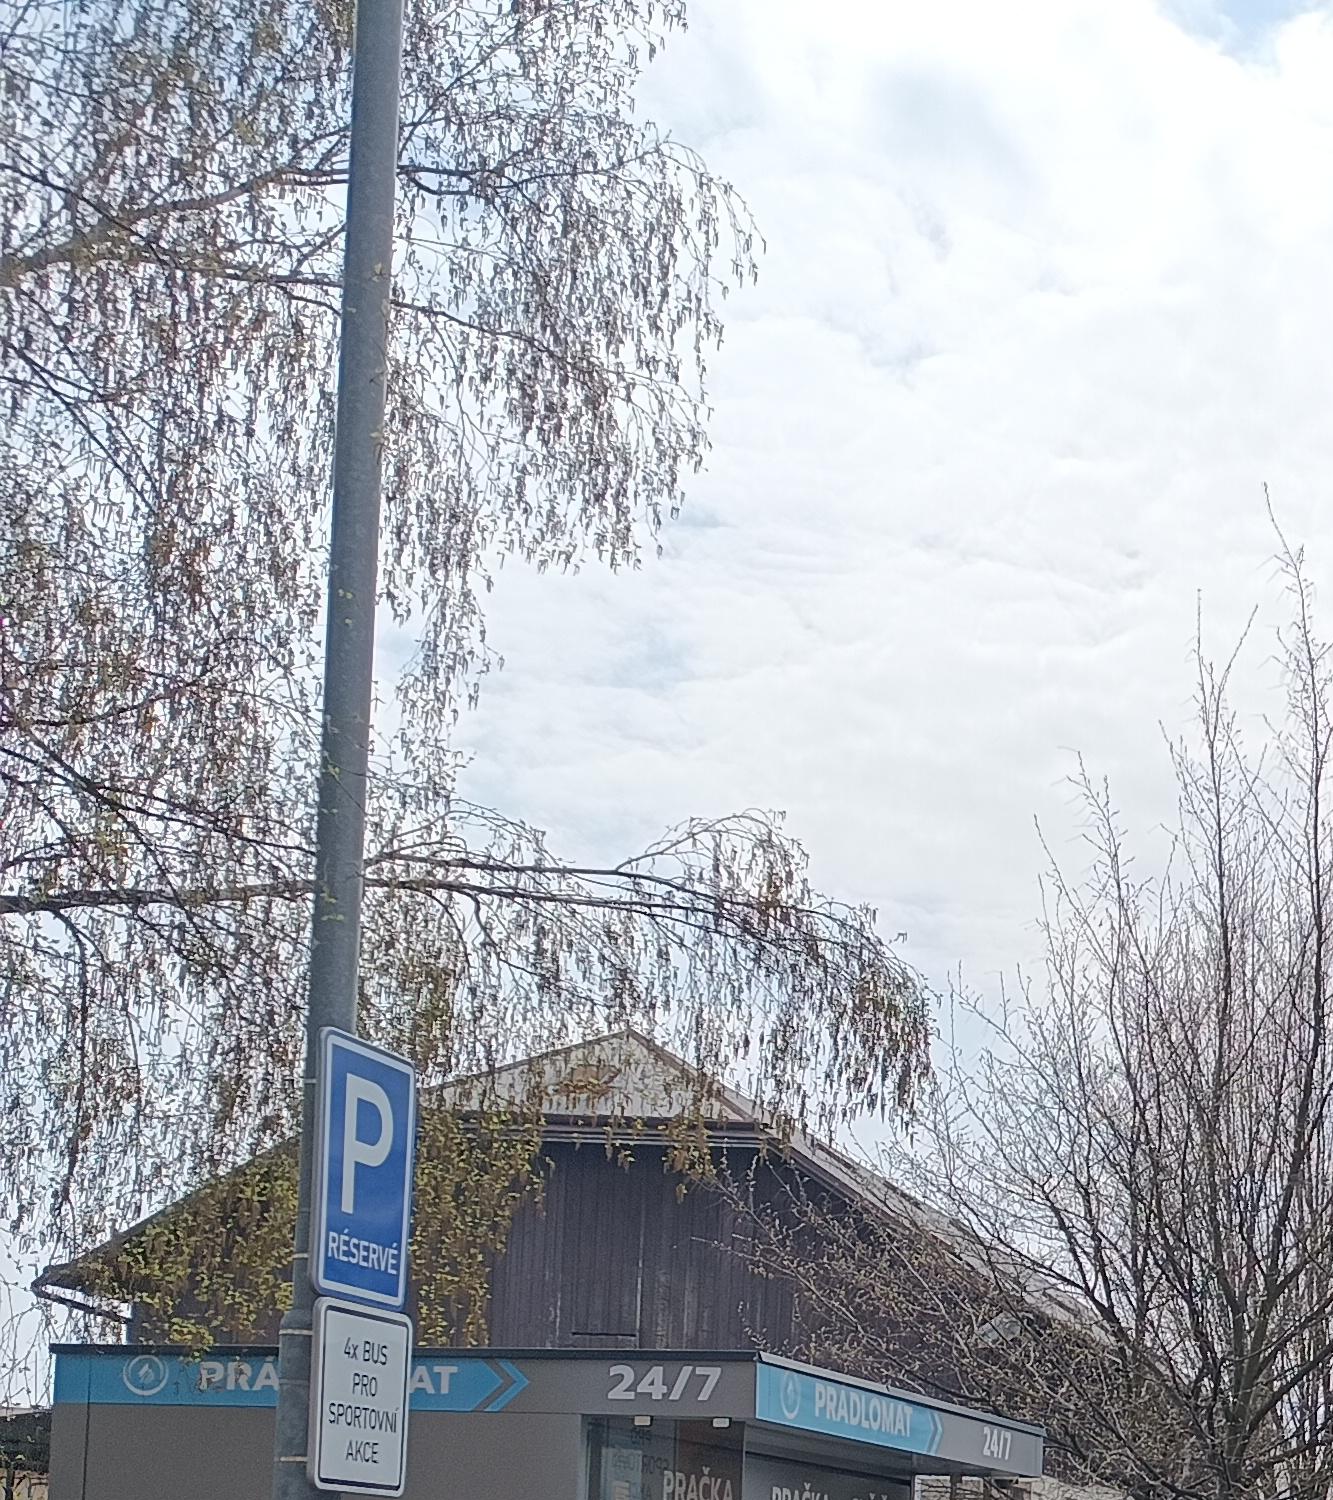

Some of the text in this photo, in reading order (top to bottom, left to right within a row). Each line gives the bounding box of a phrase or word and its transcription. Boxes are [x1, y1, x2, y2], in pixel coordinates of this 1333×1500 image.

[341, 1072, 394, 1215] P
[327, 1228, 399, 1276] RÉSERVÉ
[343, 1337, 388, 1366] 4x BUS
[199, 1355, 459, 1394] PRÁAT
[352, 1372, 378, 1397] PRO
[607, 1364, 722, 1401] 24/7
[328, 1402, 400, 1433] SPORTOVNÍ
[345, 1440, 380, 1464] AKCE
[983, 1426, 1013, 1461] 24/7
